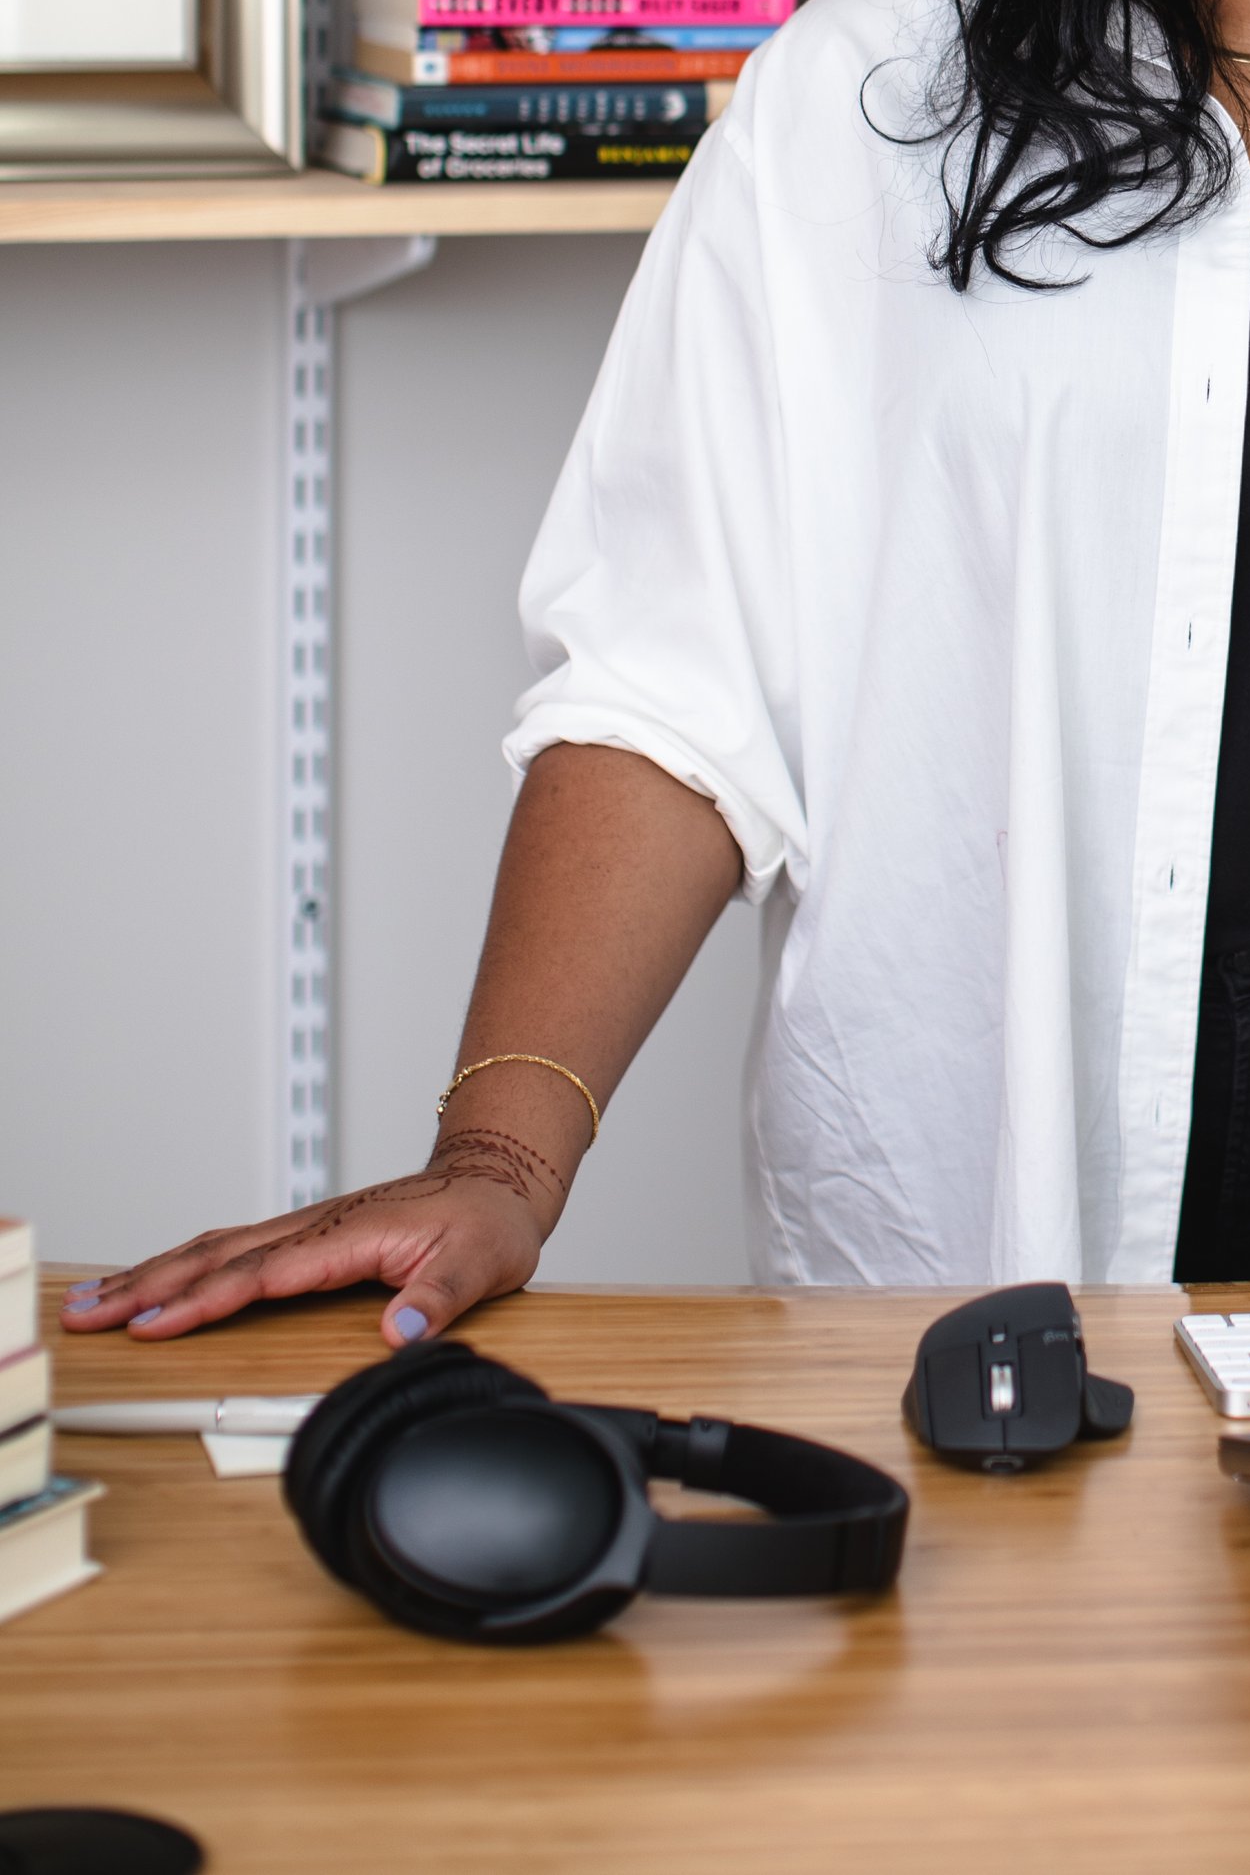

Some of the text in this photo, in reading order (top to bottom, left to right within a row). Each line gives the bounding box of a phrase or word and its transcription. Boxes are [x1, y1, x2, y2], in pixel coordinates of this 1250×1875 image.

[403, 130, 566, 158] The Secret Life
[597, 144, 693, 166] BENJAMIN
[416, 155, 550, 180] of Groceries
